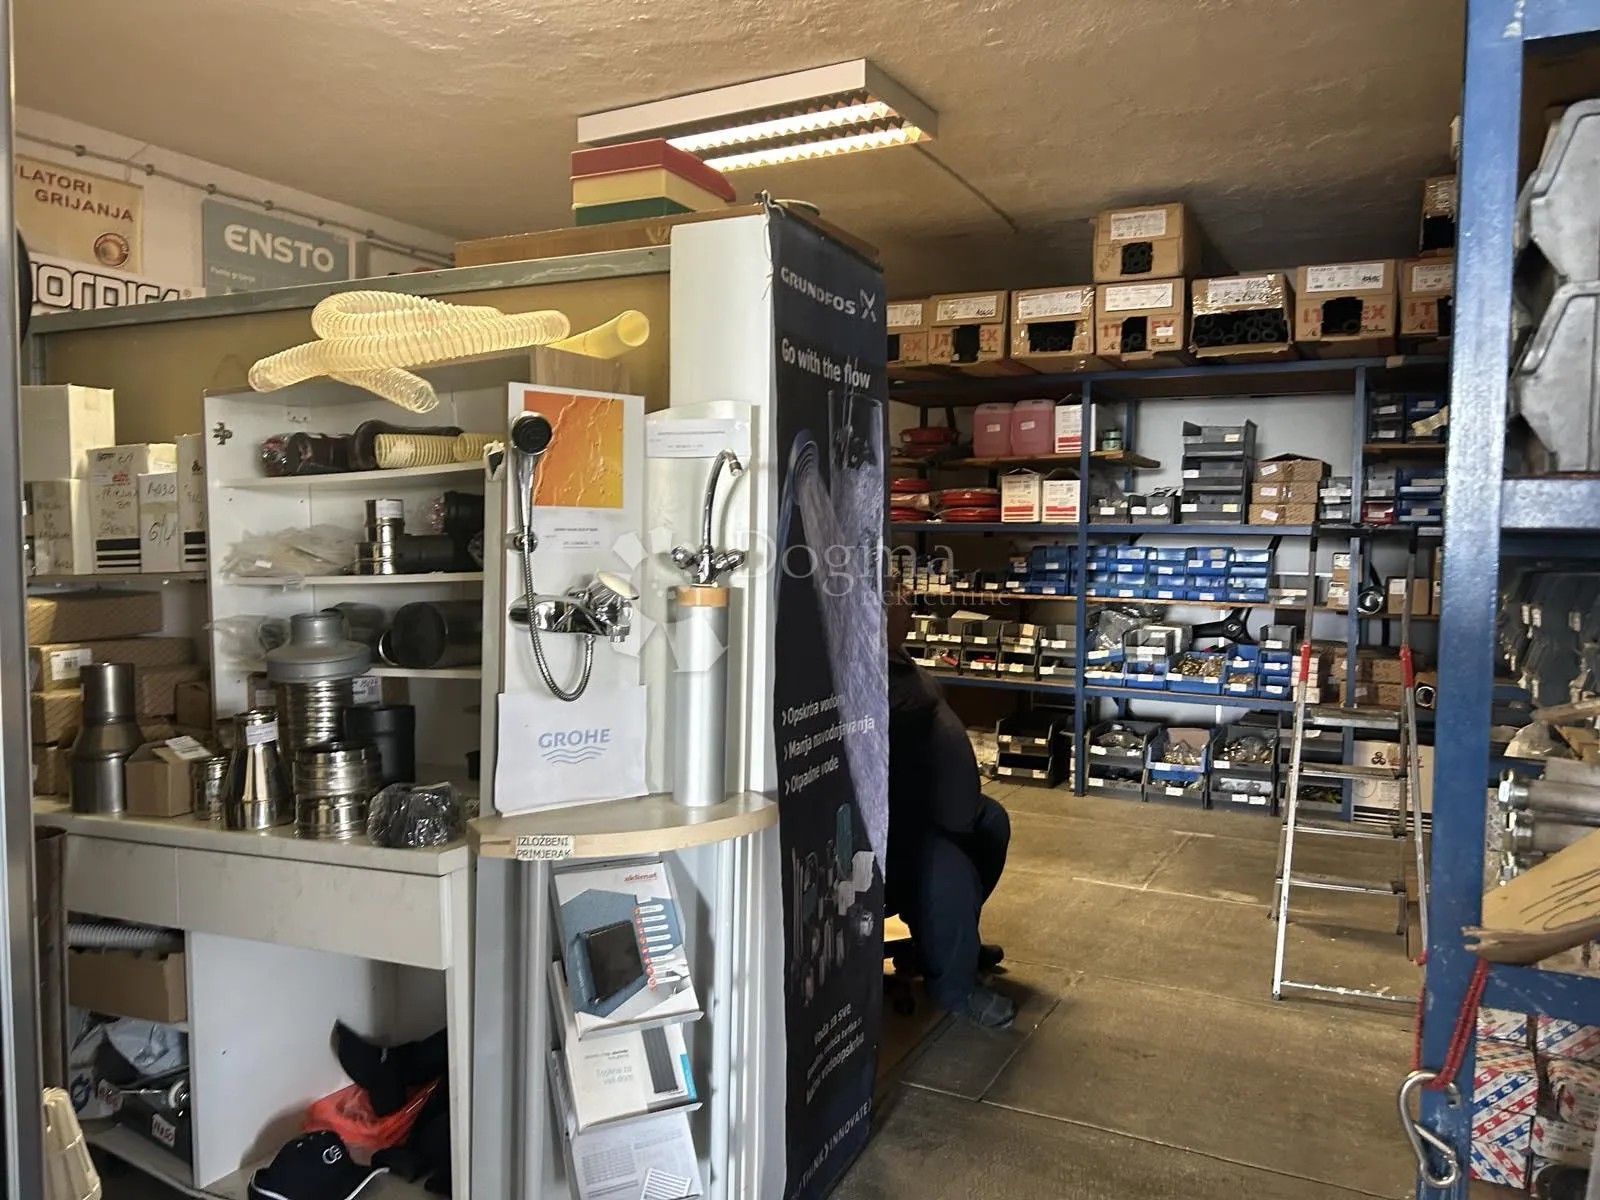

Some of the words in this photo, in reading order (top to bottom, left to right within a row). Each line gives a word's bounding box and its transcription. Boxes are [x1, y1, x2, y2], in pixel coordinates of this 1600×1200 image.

[15, 163, 93, 195] LATORI
[34, 188, 134, 222] GRIJANJA
[224, 223, 335, 273] ENSTO
[780, 265, 857, 316] GRUNDFOS
[781, 337, 797, 365] Go
[797, 347, 821, 375] with
[822, 356, 842, 382] the
[844, 356, 871, 389] flow
[787, 701, 819, 727] Opskrba
[538, 728, 611, 749] GROHE
[789, 734, 813, 757] Manja
[813, 714, 875, 748] navodnjavanja
[516, 848, 571, 860] PRIMJERAK
[517, 833, 569, 847] IZLOŽBENI
[829, 1101, 868, 1151] INNOVATE
